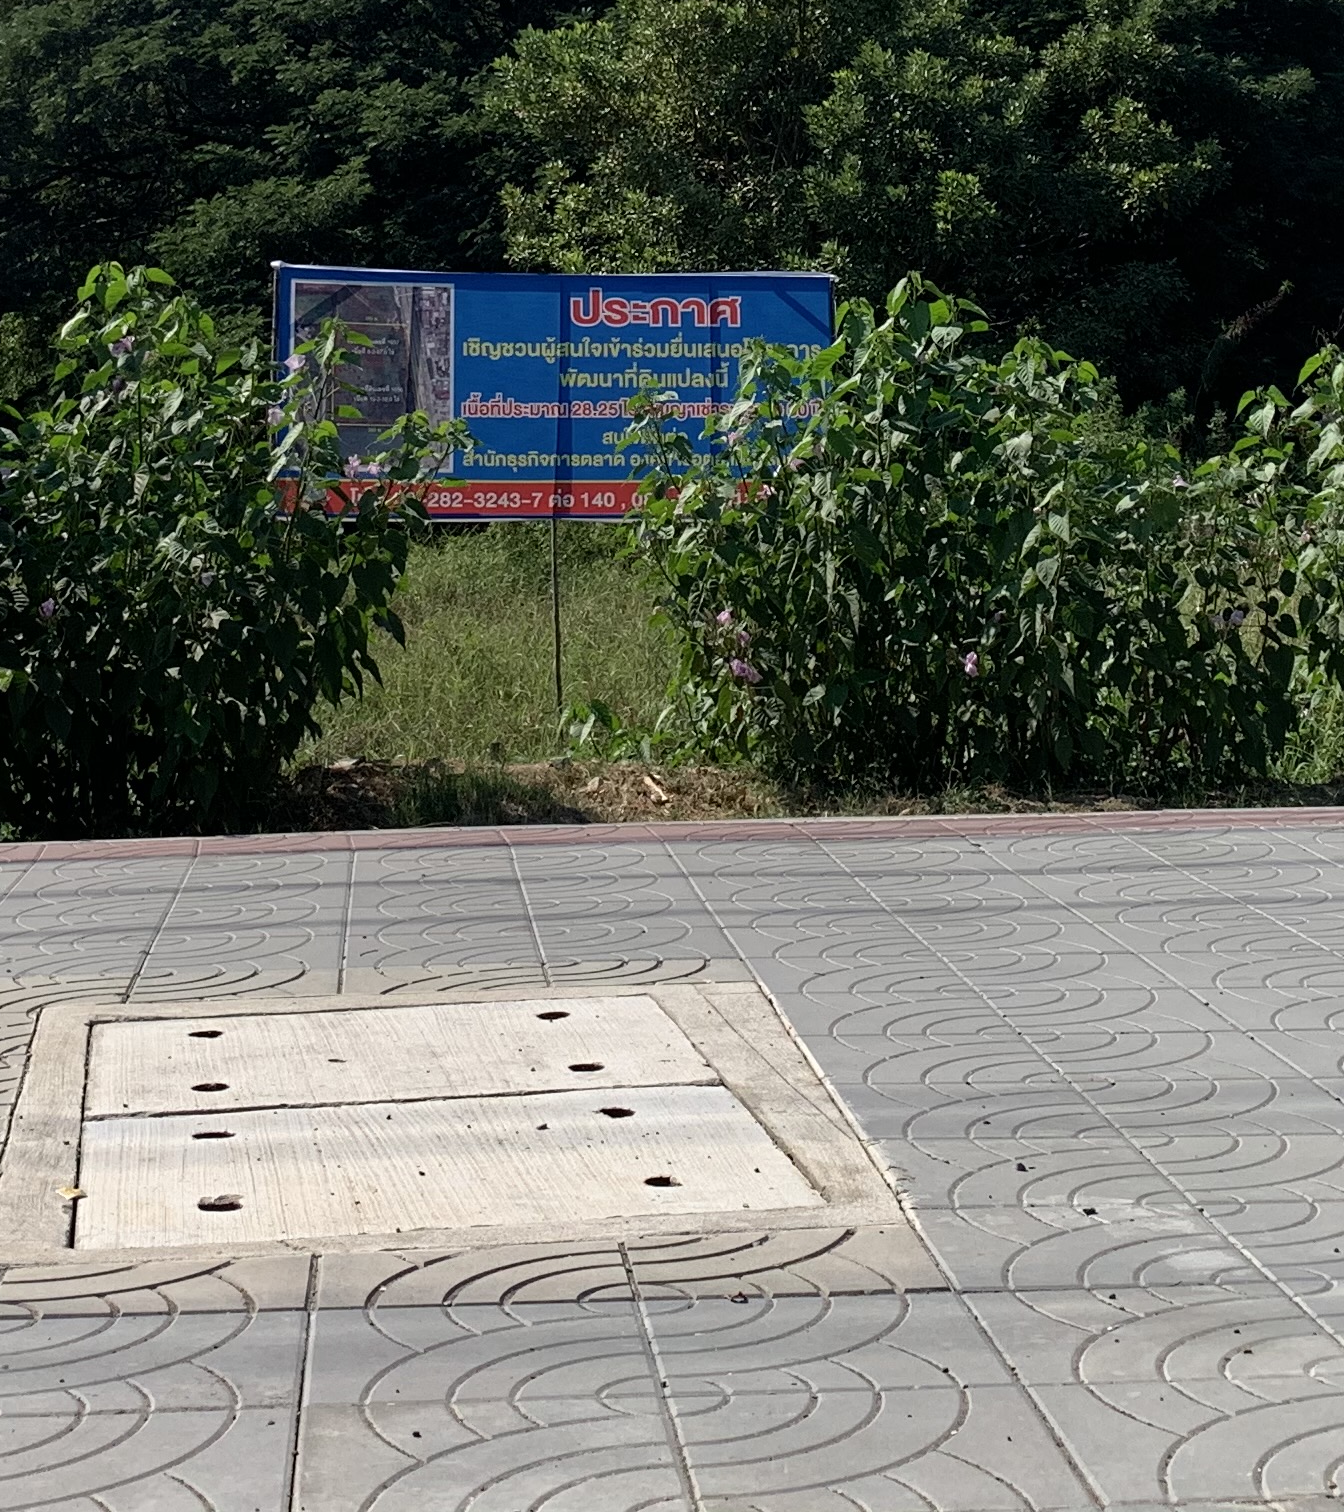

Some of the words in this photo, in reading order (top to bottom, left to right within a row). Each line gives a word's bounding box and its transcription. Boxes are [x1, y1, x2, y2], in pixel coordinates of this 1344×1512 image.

[570, 287, 741, 327] ประกาศ
[560, 362, 729, 388] พัฒนาที่ดินแปลงนี้
[461, 392, 568, 419] เนื้อที่ประมาณ
[570, 400, 619, 419] 28.25
[462, 449, 625, 473] สำนักธุรกิจการตลาด
[548, 488, 575, 508] ต่อ
[582, 491, 616, 508] 140
